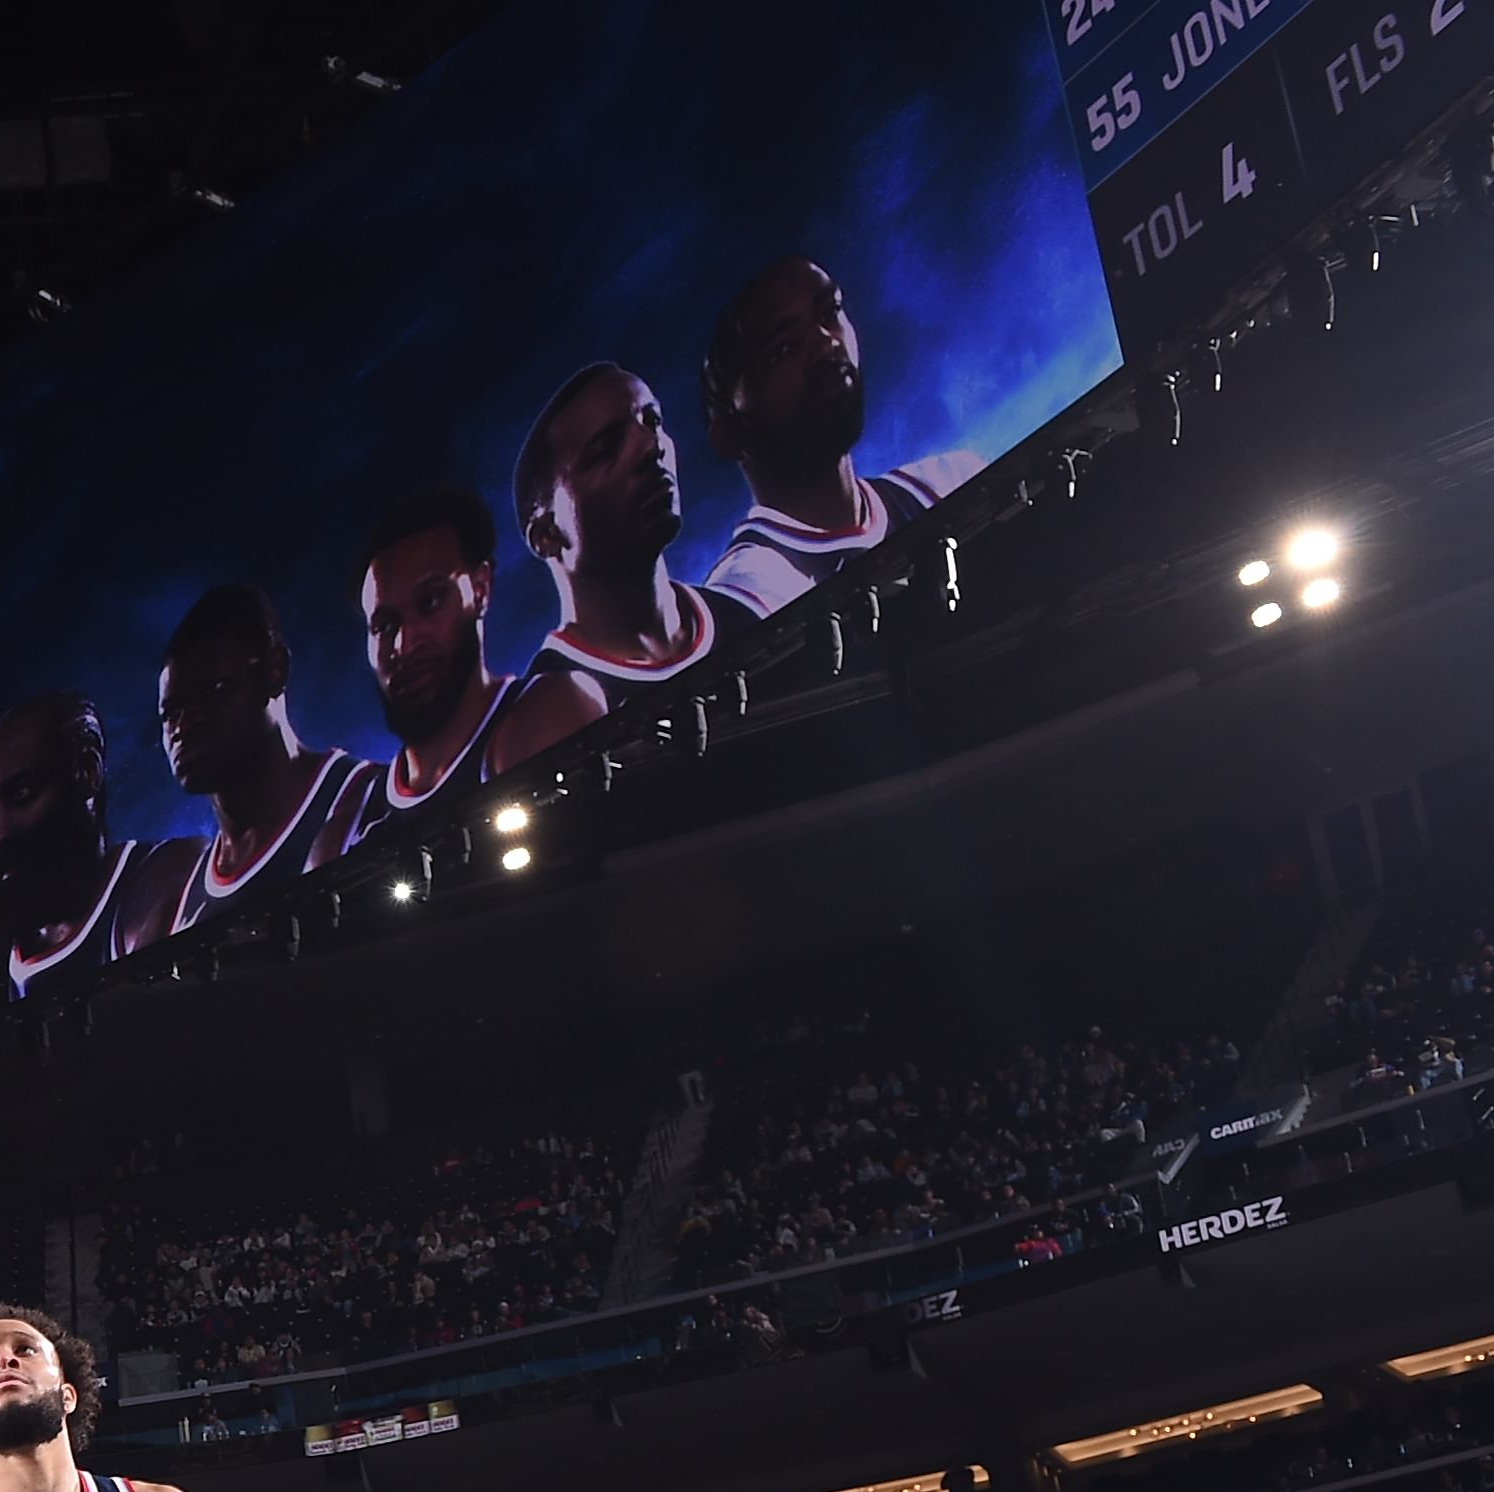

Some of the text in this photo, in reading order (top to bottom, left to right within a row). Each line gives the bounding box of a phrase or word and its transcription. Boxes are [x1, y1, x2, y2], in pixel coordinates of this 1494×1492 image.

[1325, 12, 1406, 116] FLS
[1086, 72, 1142, 152] 55
[1122, 141, 1257, 276] TOL 4
[1158, 1196, 1288, 1253] HERDEZ
